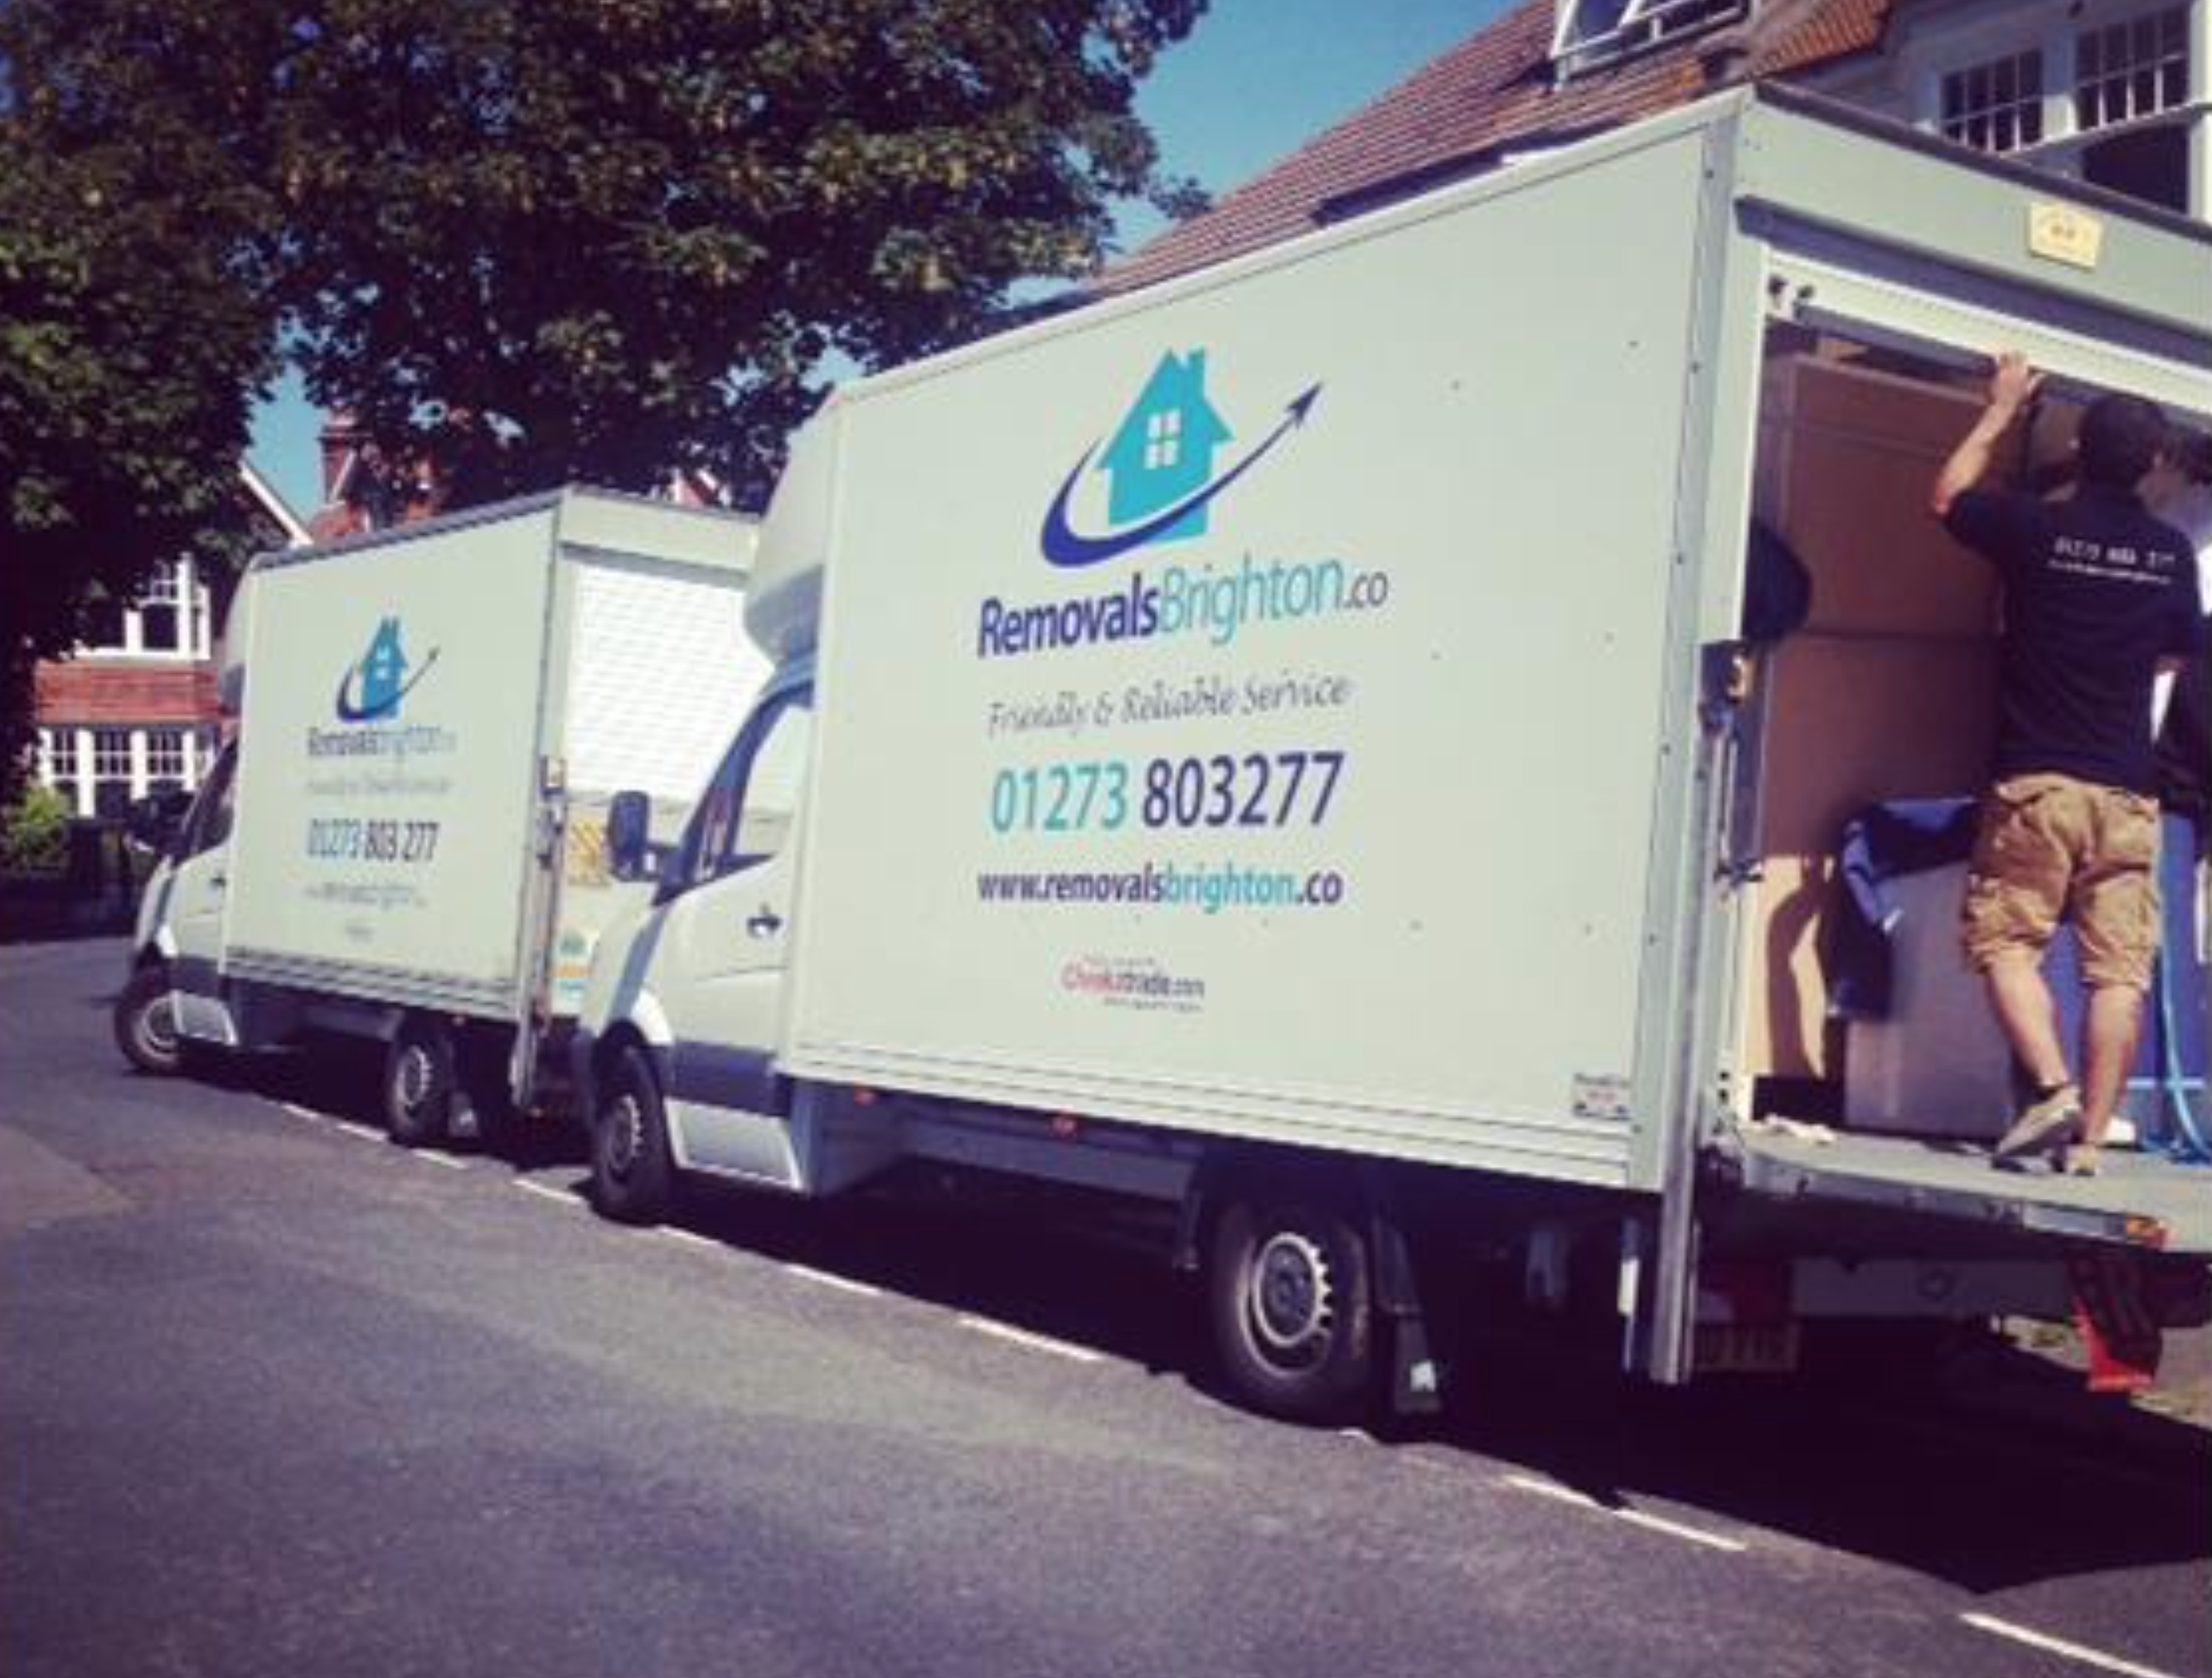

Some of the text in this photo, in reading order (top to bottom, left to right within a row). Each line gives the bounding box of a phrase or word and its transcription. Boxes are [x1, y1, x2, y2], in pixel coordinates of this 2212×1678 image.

[977, 553, 1390, 658] RemovalsBrighton.co
[988, 668, 1350, 738] Friendly & Reliable Service
[991, 750, 1345, 832] 01273 803277
[308, 817, 440, 862] 01273 803 277
[977, 863, 1345, 914] www.removalsbrighton.co
